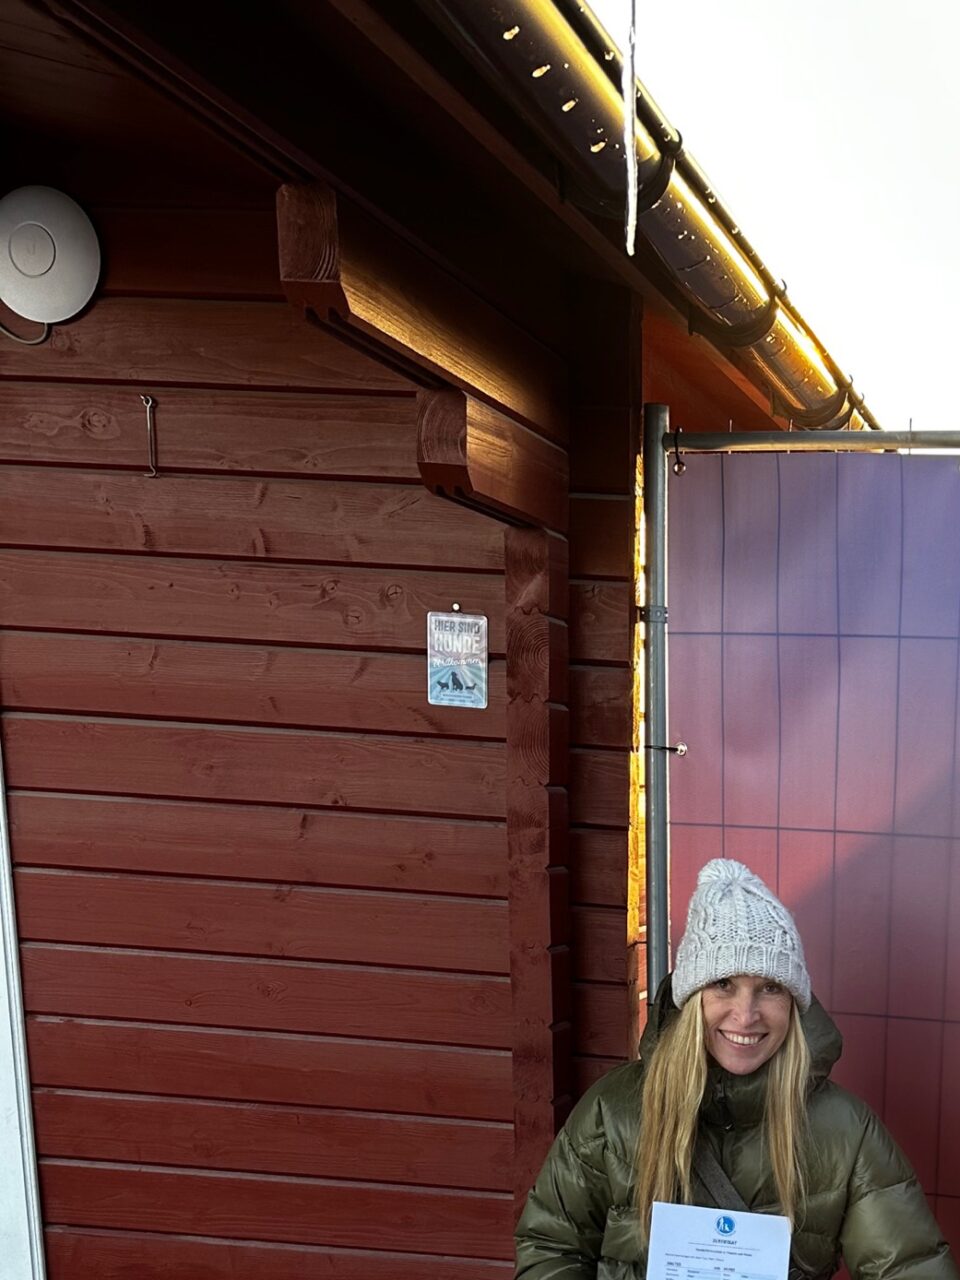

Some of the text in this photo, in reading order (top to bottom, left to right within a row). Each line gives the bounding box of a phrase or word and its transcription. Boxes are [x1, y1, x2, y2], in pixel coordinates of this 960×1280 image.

[434, 618, 480, 634] HIER SIND
[434, 633, 481, 654] HUNDE
